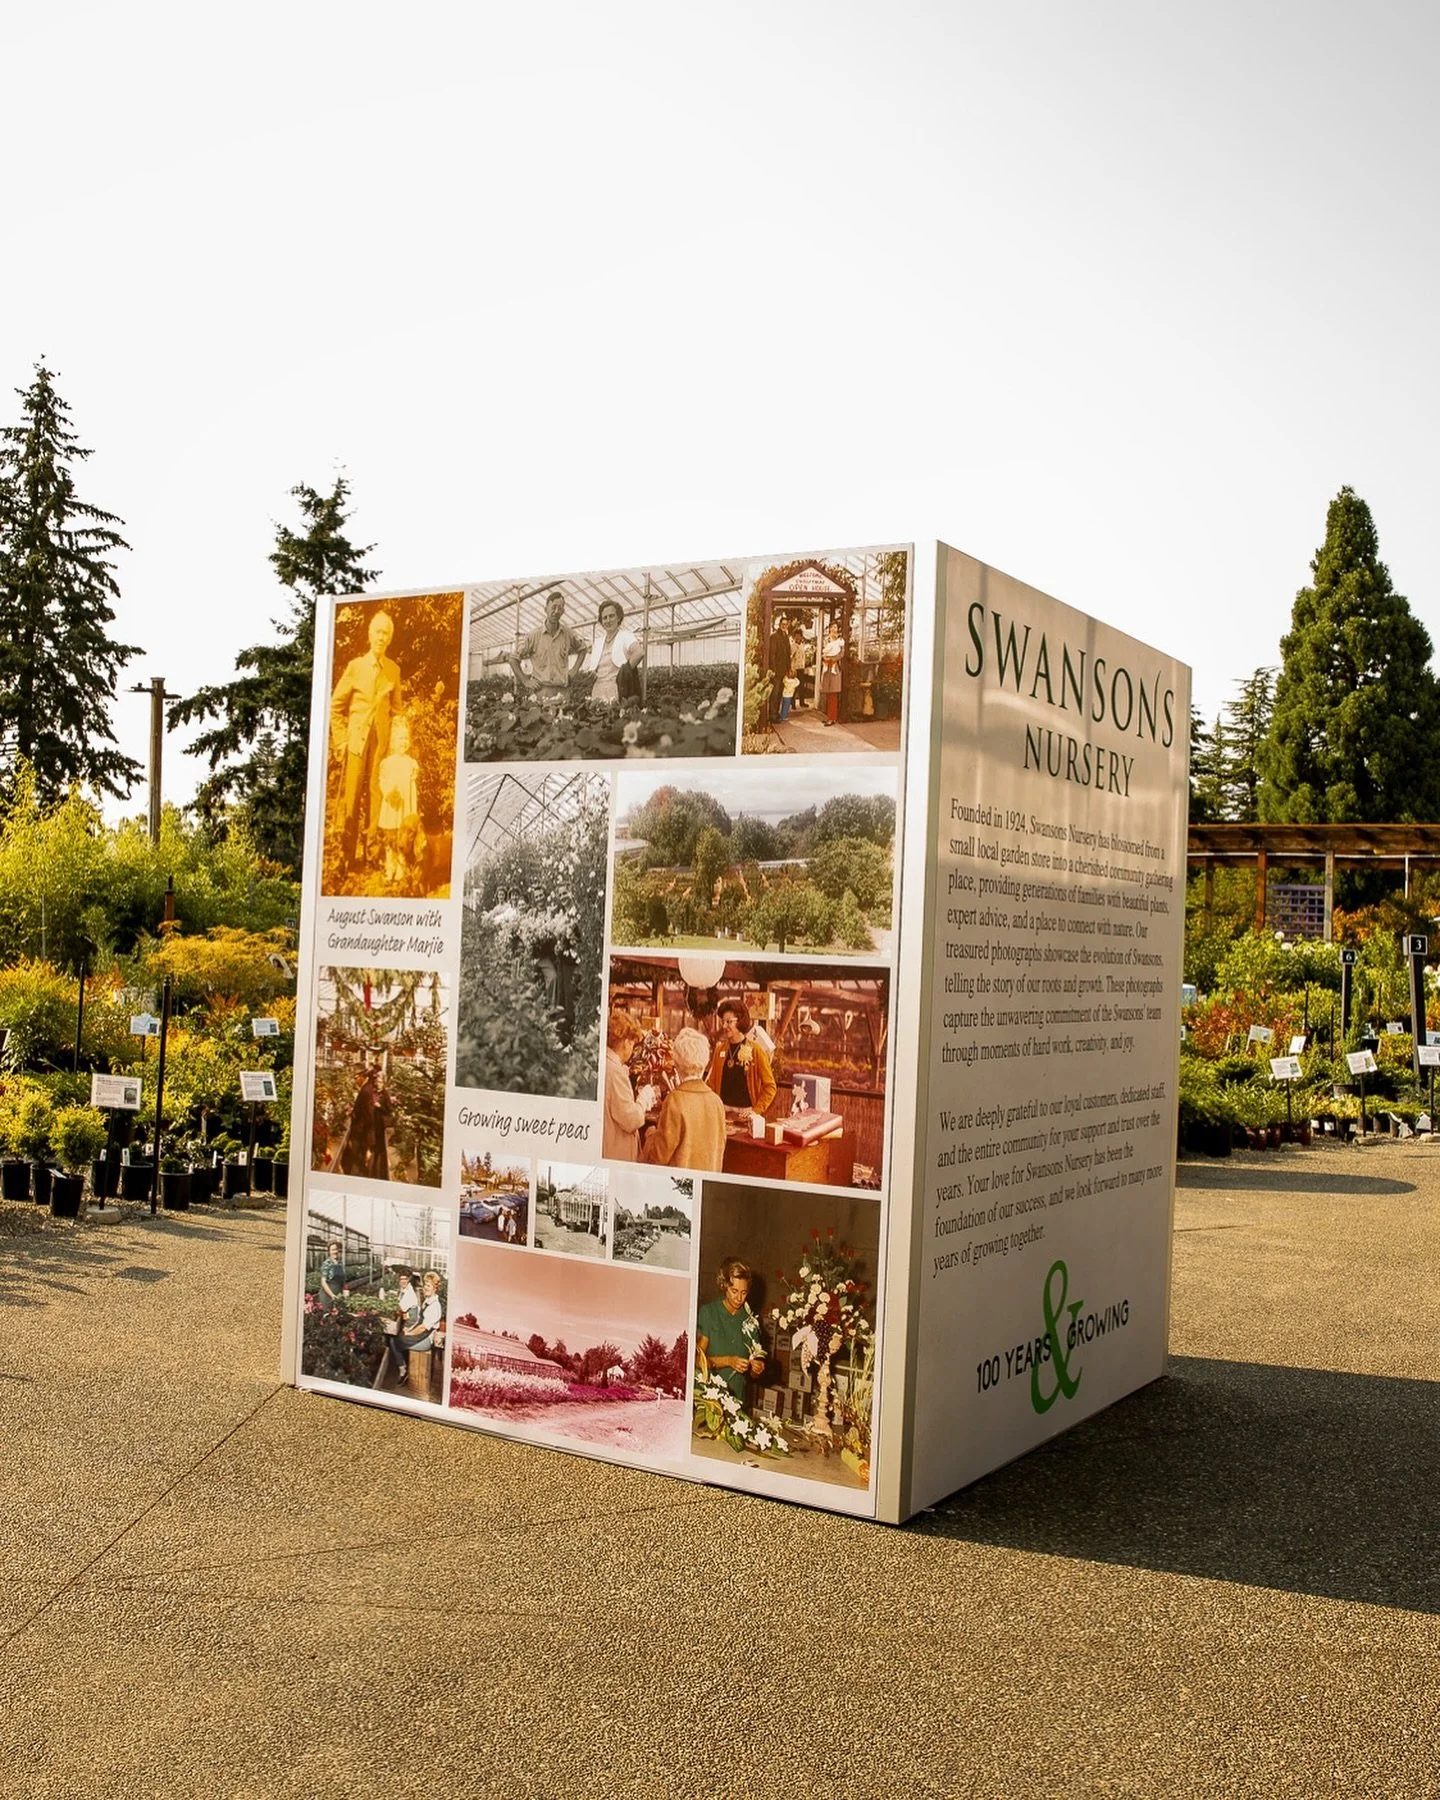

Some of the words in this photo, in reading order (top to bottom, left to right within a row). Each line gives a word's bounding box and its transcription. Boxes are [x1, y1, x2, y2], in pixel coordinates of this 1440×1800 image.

[1023, 723, 1135, 797] NURSERY
[951, 798, 992, 826] Founded
[994, 807, 1003, 828] in
[1005, 810, 1029, 836] 1924,
[1030, 815, 1068, 841] Swansons
[1069, 824, 1098, 851] Nursery
[1098, 830, 1110, 849] has
[1111, 833, 1144, 856] blossomed
[1145, 841, 1160, 859] from
[1161, 848, 1165, 860] a
[949, 836, 975, 857] small
[977, 838, 999, 861] local
[1000, 844, 1030, 868] garden
[1031, 851, 1050, 869] store
[1052, 851, 1068, 871] into
[1068, 859, 1073, 872] a
[1075, 856, 1108, 878] cherished
[1109, 866, 1144, 888] community
[1145, 869, 1173, 892] gathering
[948, 868, 976, 894] place,
[979, 874, 1020, 902] providing
[1022, 881, 1067, 902] generations
[1068, 884, 1077, 903] of
[1078, 885, 1105, 906] families
[1107, 890, 1121, 908] with
[1122, 891, 1149, 911] beautiful
[327, 908, 366, 930] August
[367, 908, 413, 926] Swanson
[416, 909, 442, 928] with
[947, 908, 977, 930] expert
[979, 906, 1011, 930] advice,
[1012, 909, 1028, 929] and
[1029, 915, 1034, 929] a
[1035, 911, 1057, 935] place
[1058, 917, 1066, 932] to
[1067, 919, 1095, 934] connect
[1097, 918, 1111, 935] with
[1113, 922, 1134, 937] nature.
[1136, 921, 1148, 938] Our
[327, 932, 405, 957] Grandaughter
[406, 936, 444, 958] Marjie
[946, 939, 989, 959] treasured
[991, 940, 1042, 966] photographs
[1043, 943, 1079, 962] showcase
[1080, 944, 1091, 963] the
[1093, 946, 1123, 964] evolution
[1125, 947, 1132, 964] of
[1415, 938, 1422, 950] 3
[945, 972, 974, 999] telling
[976, 972, 991, 992] the
[992, 977, 1013, 998] story
[1016, 973, 1026, 993] of
[1027, 979, 1040, 993] our
[1041, 978, 1061, 993] roots
[1063, 974, 1076, 992] and
[1106, 975, 1124, 992] These
[1125, 975, 1163, 998] photographs
[943, 1010, 978, 1034] capture
[980, 1006, 995, 1027] the
[997, 1005, 1044, 1029] unwavering
[1046, 1004, 1091, 1024] commitment
[1093, 1003, 1101, 1021] of
[1102, 1003, 1112, 1021] the
[1146, 1005, 1162, 1020] team
[942, 1040, 978, 1067] through
[980, 1041, 1020, 1060] moments
[1022, 1036, 1032, 1056] of
[1032, 1035, 1051, 1055] hard
[1110, 1032, 1122, 1049] and
[458, 1106, 512, 1137] Growing
[514, 1116, 556, 1136] sweet
[555, 1122, 591, 1143] peas
[940, 1111, 956, 1132] We
[958, 1113, 973, 1130] are
[975, 1104, 1006, 1130] deeply
[1006, 1099, 1038, 1128] grateful
[1040, 1100, 1048, 1117] to
[1049, 1101, 1063, 1115] our
[1064, 1093, 1082, 1117] loyal
[1120, 1084, 1150, 1104] dedicated
[937, 1144, 956, 1168] and
[958, 1143, 973, 1163] the
[975, 1138, 1001, 1160] entire
[1002, 1129, 1048, 1155] community
[1049, 1126, 1062, 1146] for
[1062, 1127, 1080, 1148] your
[1080, 1122, 1106, 1144] support
[1107, 1115, 1120, 1134] and
[1121, 1116, 1135, 1132] trust
[1136, 1115, 1150, 1129] over
[1151, 1109, 1160, 1126] the
[936, 1183, 964, 1209] years.
[967, 1173, 989, 1195] Your
[991, 1170, 1010, 1190] love
[1011, 1165, 1024, 1185] for
[1026, 1161, 1064, 1181] Swansons
[1064, 1153, 1093, 1172] Nursery
[1094, 1148, 1105, 1166] has
[1107, 1145, 1122, 1162] been
[1124, 1141, 1133, 1159] the
[935, 1207, 986, 1238] foundation
[987, 1201, 998, 1223] of
[999, 1203, 1014, 1220] our
[1049, 1185, 1063, 1206] and
[1064, 1187, 1075, 1201] we
[1076, 1178, 1092, 1199] look
[1093, 1170, 1120, 1194] forward
[1120, 1174, 1127, 1186] to
[1128, 1169, 1146, 1186] many
[1146, 1165, 1162, 1180] more
[933, 1251, 959, 1279] years
[961, 1241, 973, 1264] of
[973, 1234, 1009, 1266] growing
[1010, 1223, 1046, 1251] together.
[976, 1355, 1000, 1393] 100
[1005, 1332, 1052, 1379] YEARS
[1030, 1260, 1084, 1414] &
[1066, 1299, 1129, 1350] GROWING
